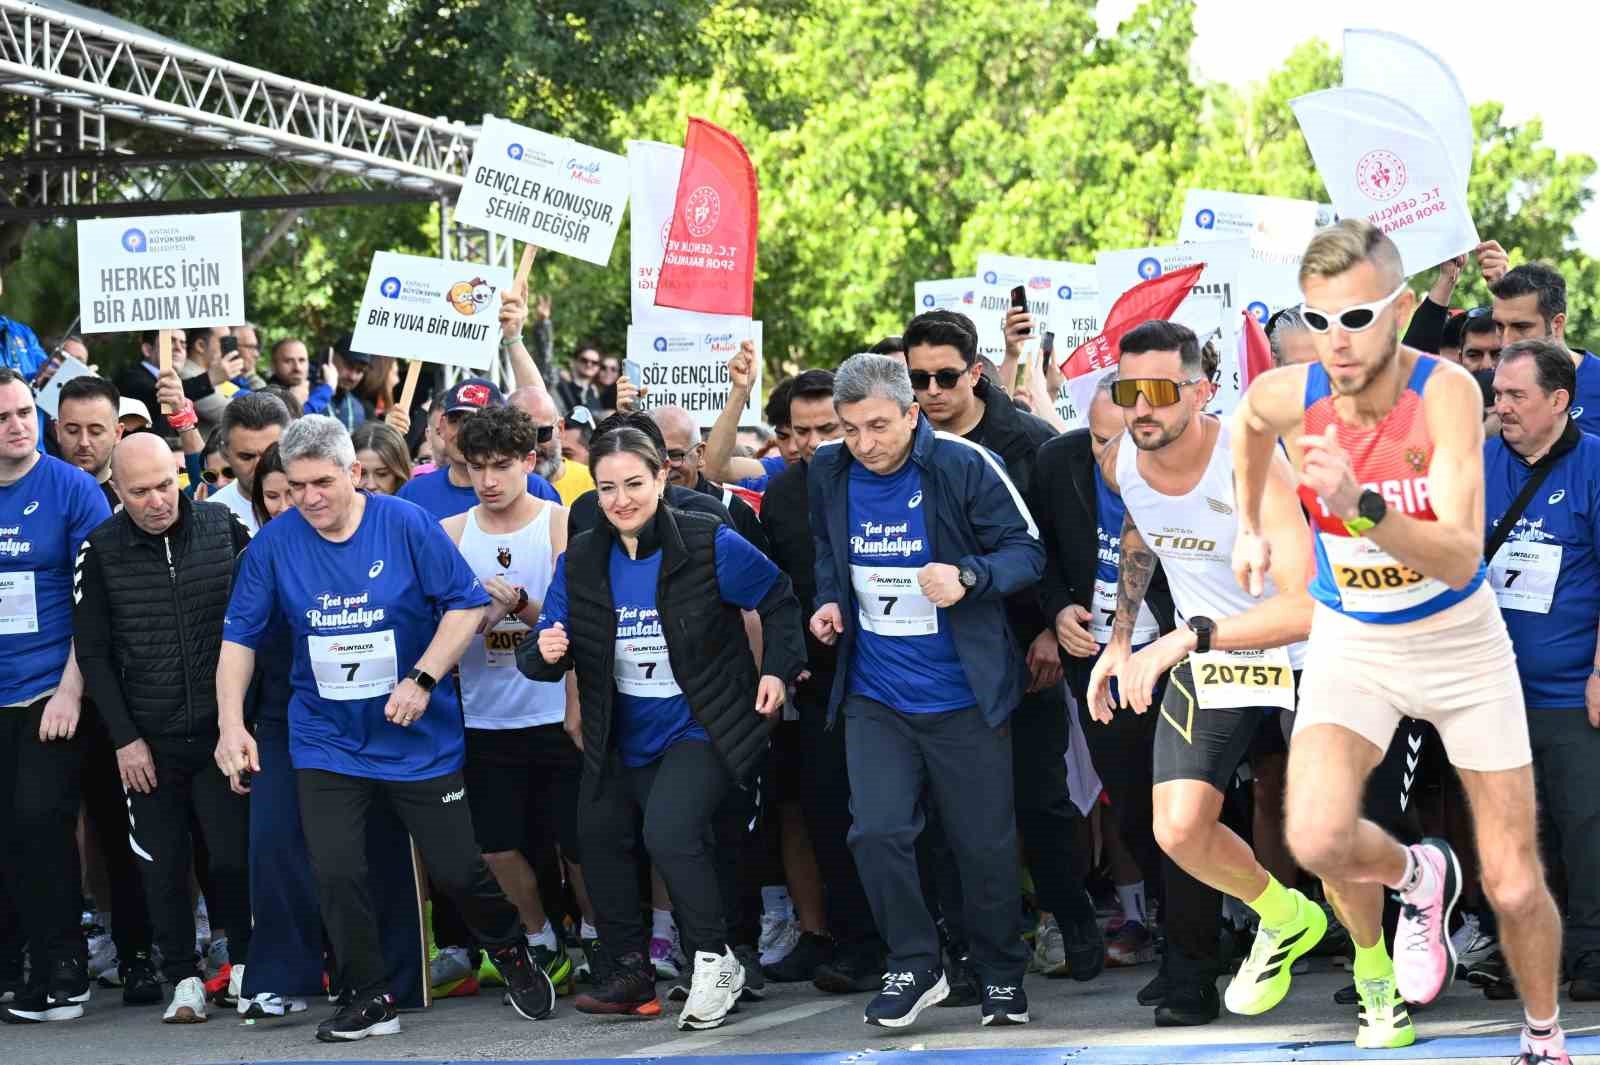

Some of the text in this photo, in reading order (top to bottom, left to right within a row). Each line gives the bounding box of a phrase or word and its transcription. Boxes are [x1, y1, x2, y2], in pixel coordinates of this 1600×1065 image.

[475, 166, 615, 226] GENÇLER KONUŞUR,
[486, 196, 590, 244] ŞEHİR DEĞİŞİR
[101, 258, 220, 293] HERKES İÇİN
[93, 293, 231, 324] BİR ADIM VAR!
[368, 307, 489, 341] BİR YUVA BİR UMUT
[1072, 315, 1099, 333] YEŞİL
[642, 360, 732, 387] SÖZ GENÇLİĞ
[885, 523, 908, 537] good
[0, 538, 31, 557] alya
[850, 536, 923, 557] Runtalya
[1342, 566, 1424, 589] 2083
[1504, 569, 1521, 588] 7
[344, 592, 368, 608] good
[878, 596, 898, 616] 7
[306, 607, 385, 628] Runtalya
[639, 608, 658, 620] goo
[1101, 608, 1116, 626] 7
[617, 621, 662, 637] untal
[338, 643, 375, 652] RUNTALYA
[490, 631, 528, 650] 206
[341, 662, 360, 681] 7
[638, 662, 657, 680] 7
[1201, 662, 1282, 686] 20757
